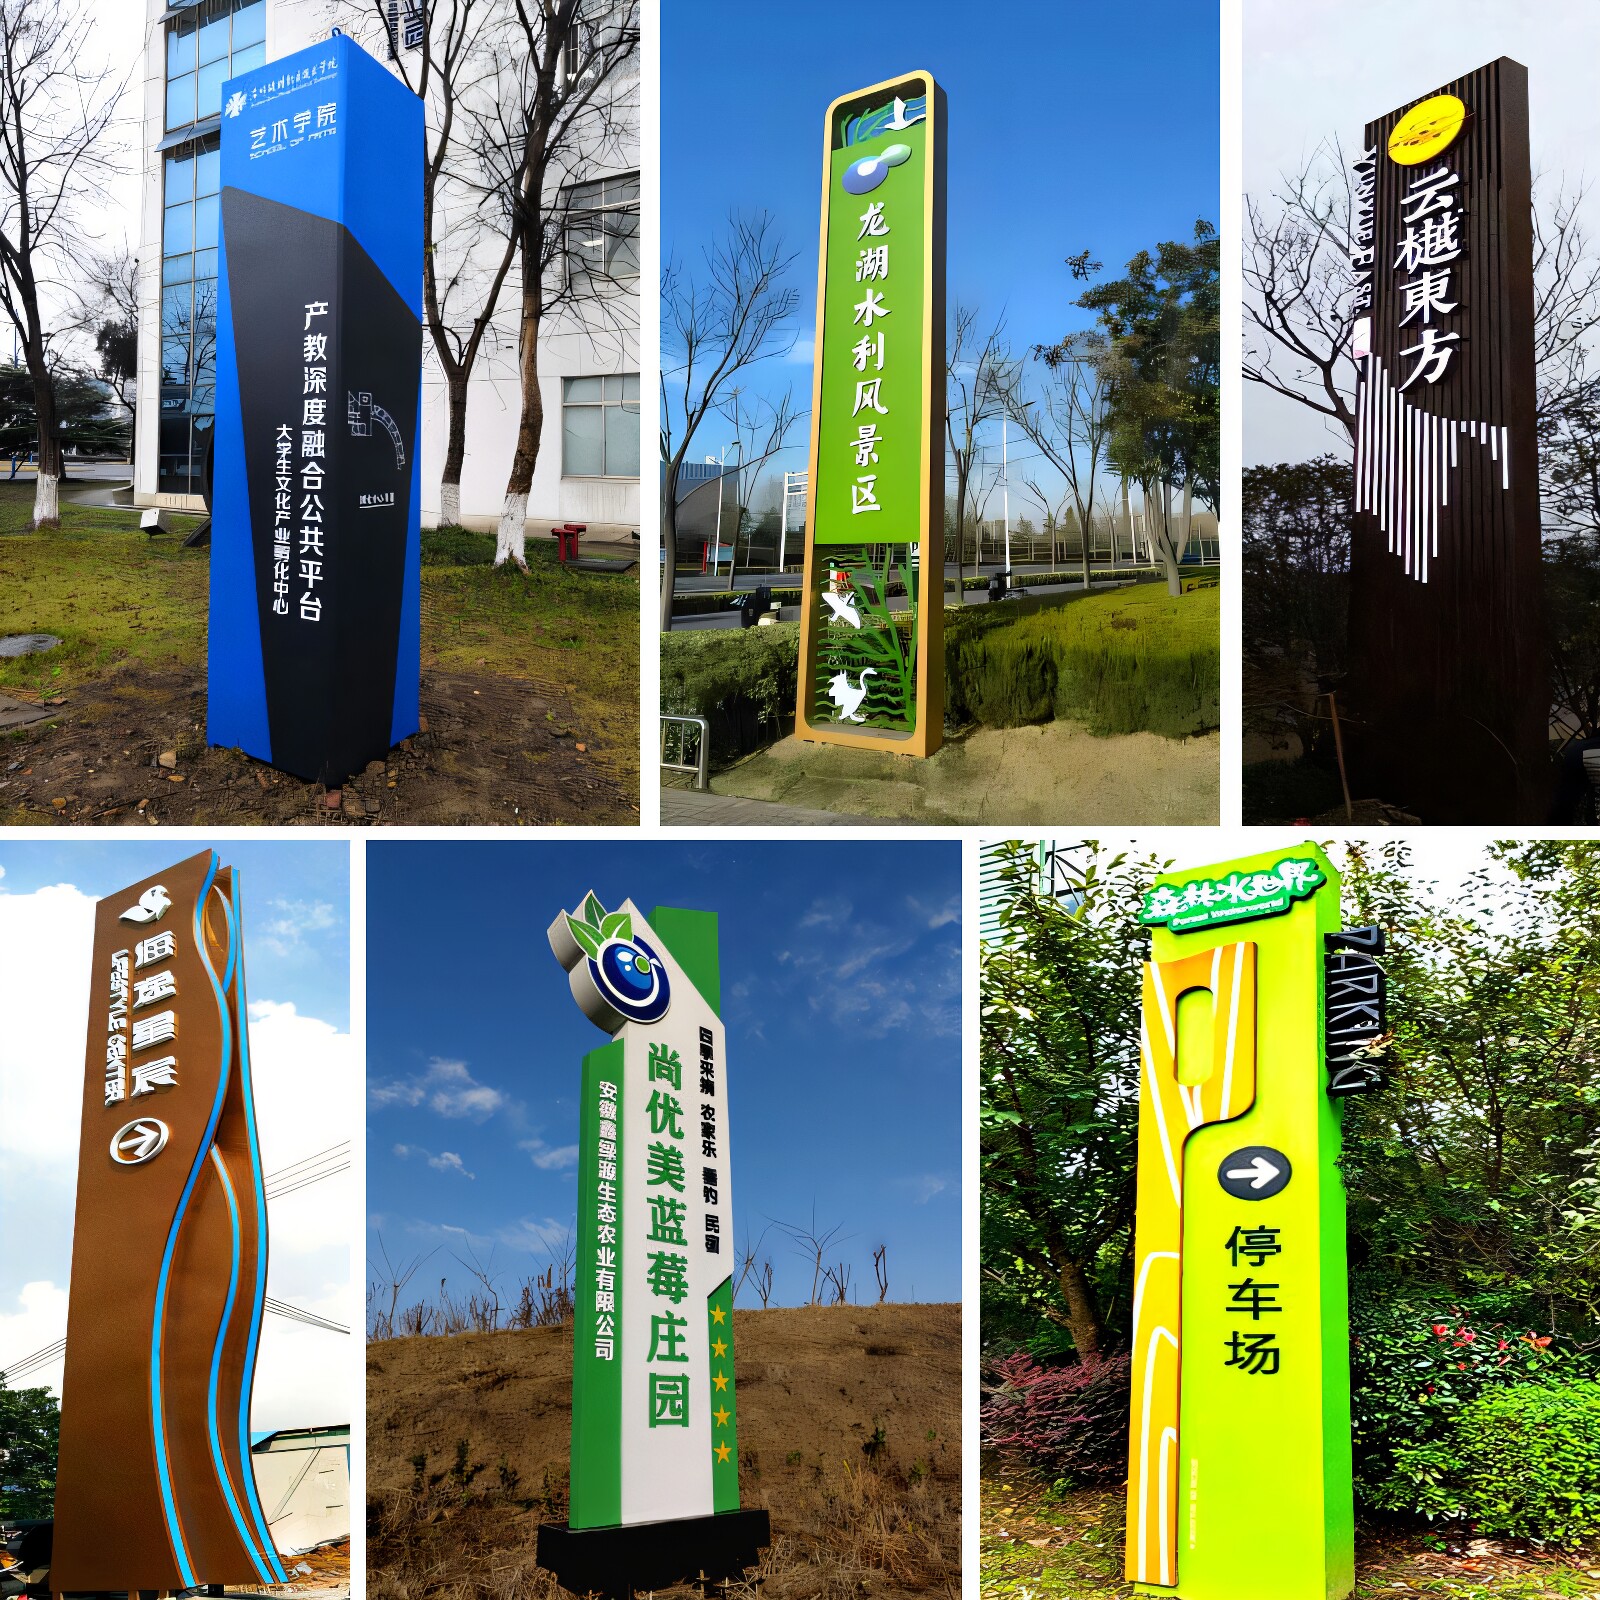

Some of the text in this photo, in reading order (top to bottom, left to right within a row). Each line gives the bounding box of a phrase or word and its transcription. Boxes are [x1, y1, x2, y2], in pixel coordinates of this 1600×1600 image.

[250, 102, 337, 150] 艺术学院
[299, 301, 329, 622] 产教深度融合公共平台
[849, 202, 892, 515] 龙湖水利风景区
[272, 424, 293, 615] 大学生文化产业孵化中心
[645, 1042, 690, 1429] 尚优美蓝莓庄园
[1224, 1224, 1282, 1375] 停车场
